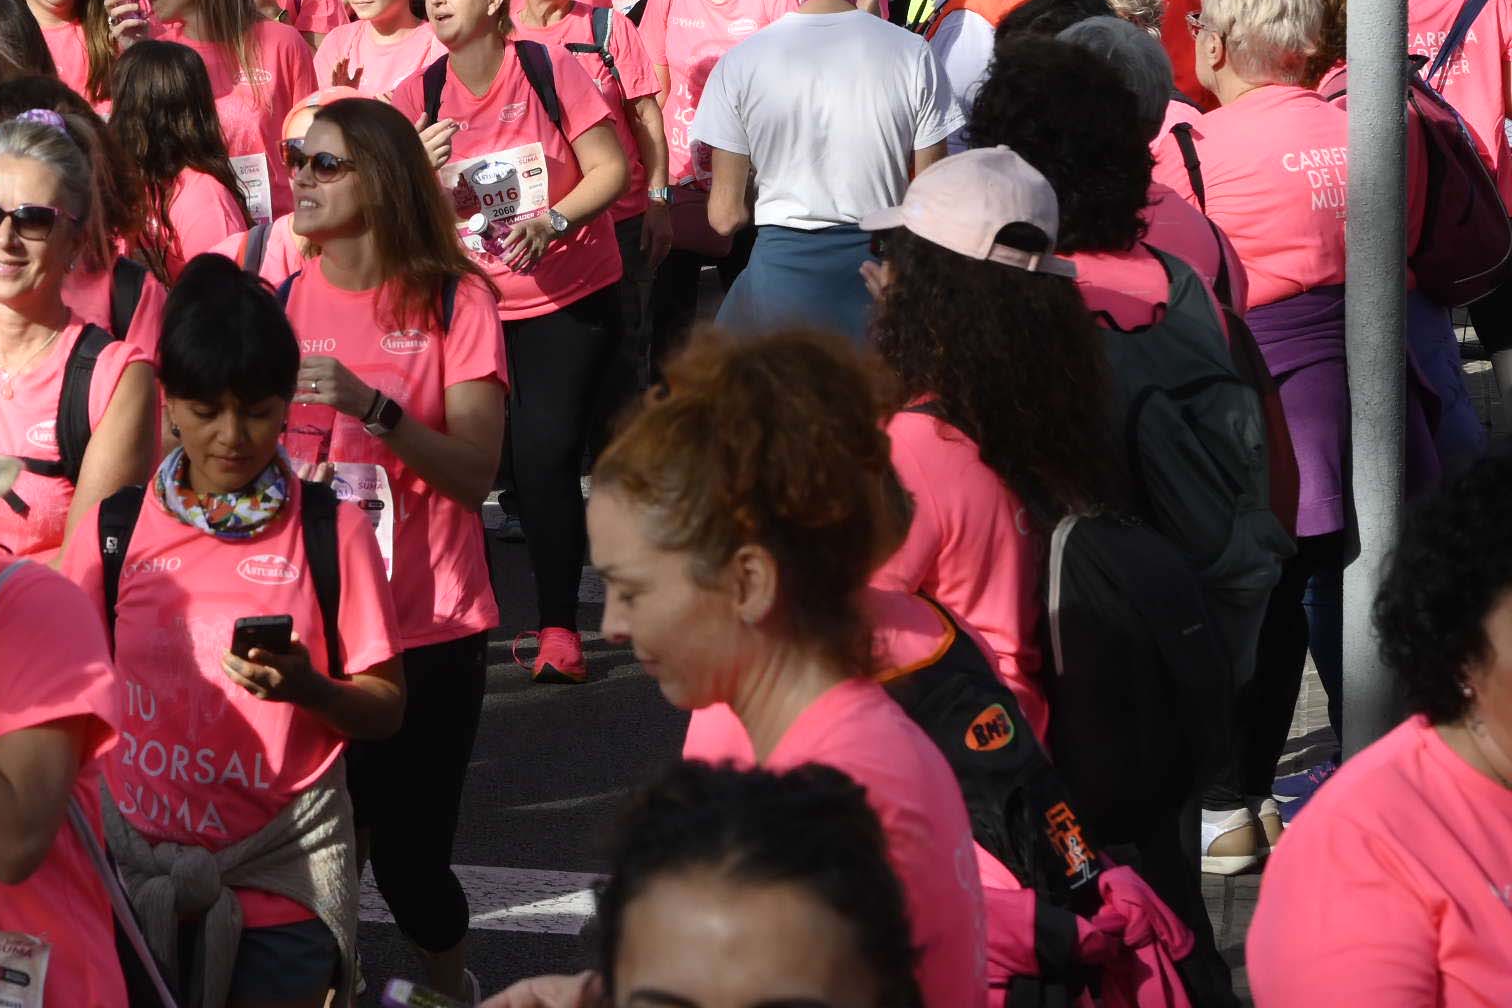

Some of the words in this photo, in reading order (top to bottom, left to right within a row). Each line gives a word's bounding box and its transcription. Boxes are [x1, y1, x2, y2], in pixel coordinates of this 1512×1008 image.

[1307, 168, 1333, 189] DE
[483, 188, 519, 206] 016
[492, 205, 516, 218] 2060
[242, 564, 295, 579] ASTURIANA
[119, 732, 270, 789] DORSAL
